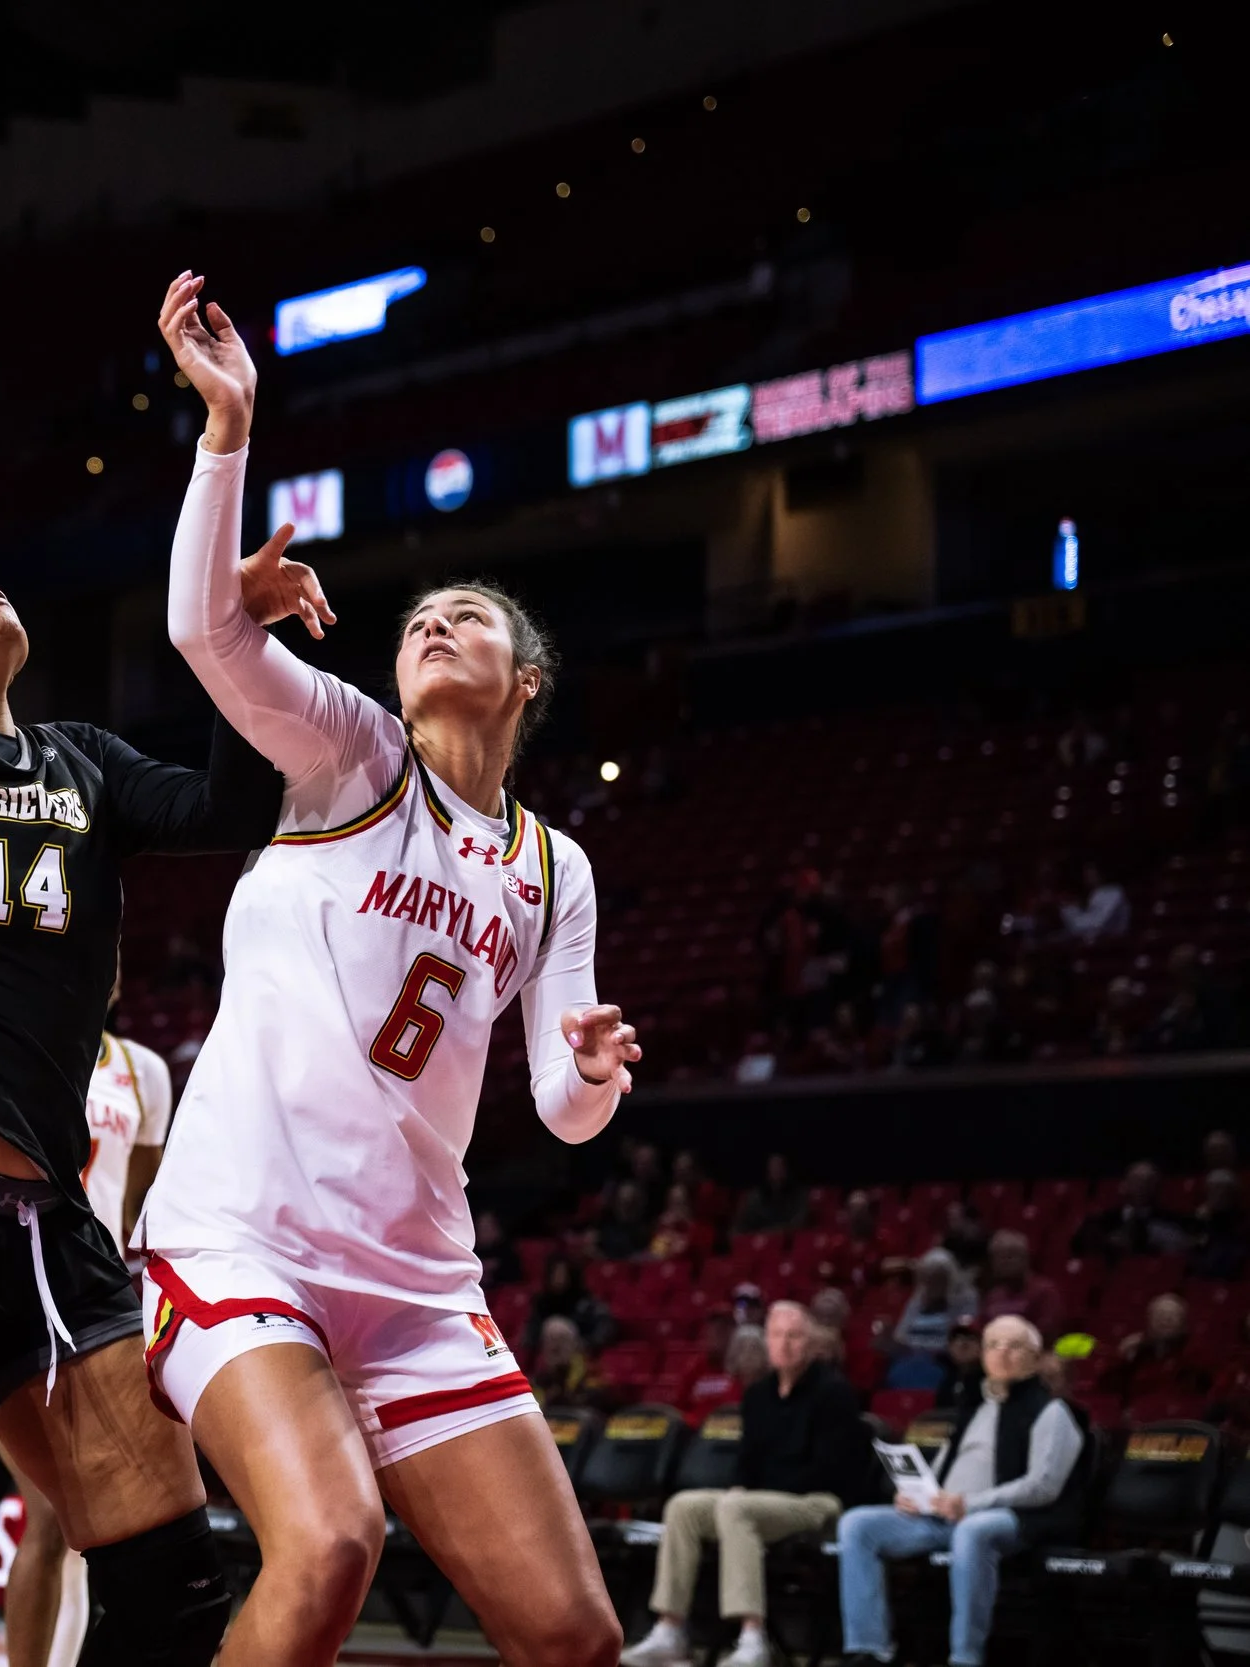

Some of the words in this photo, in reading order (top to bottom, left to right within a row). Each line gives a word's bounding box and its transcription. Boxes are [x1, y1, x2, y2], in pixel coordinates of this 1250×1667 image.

[1170, 287, 1250, 331] Chesa
[357, 871, 518, 998] MARYLAND
[369, 952, 466, 1081] 6
